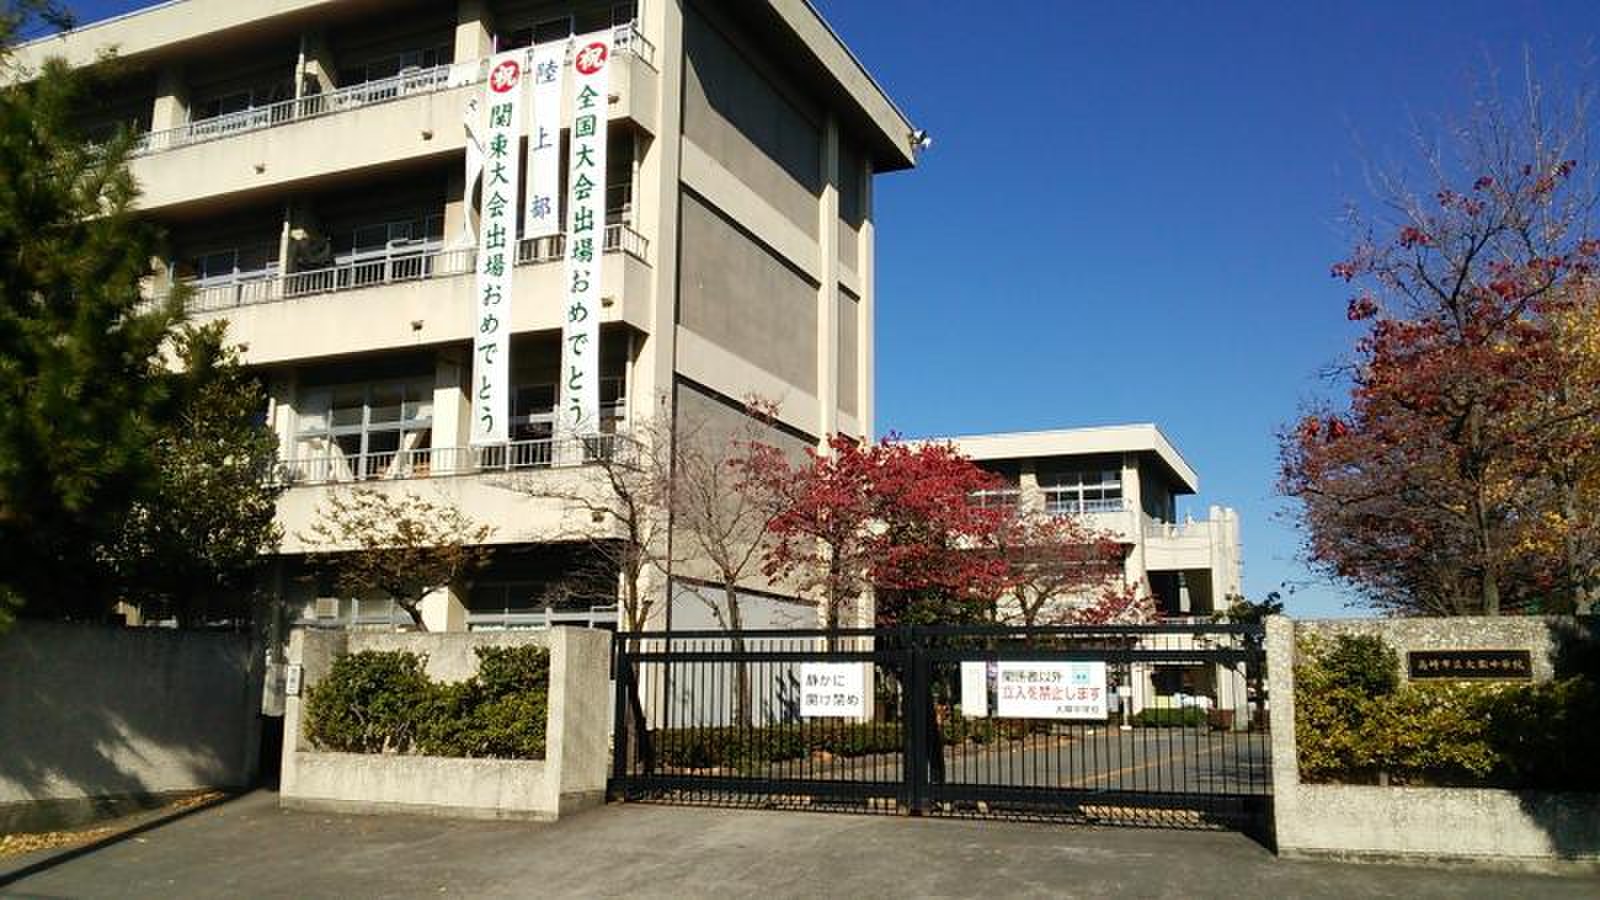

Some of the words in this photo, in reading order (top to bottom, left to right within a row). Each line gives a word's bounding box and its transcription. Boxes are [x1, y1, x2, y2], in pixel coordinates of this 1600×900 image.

[530, 61, 559, 219] 陸上部
[477, 102, 513, 432] 関東大会出場おめでとう
[567, 84, 598, 425] 全国大会出場おめでとう
[805, 673, 845, 687] 静かに
[1002, 685, 1101, 701] 立入を禁止します
